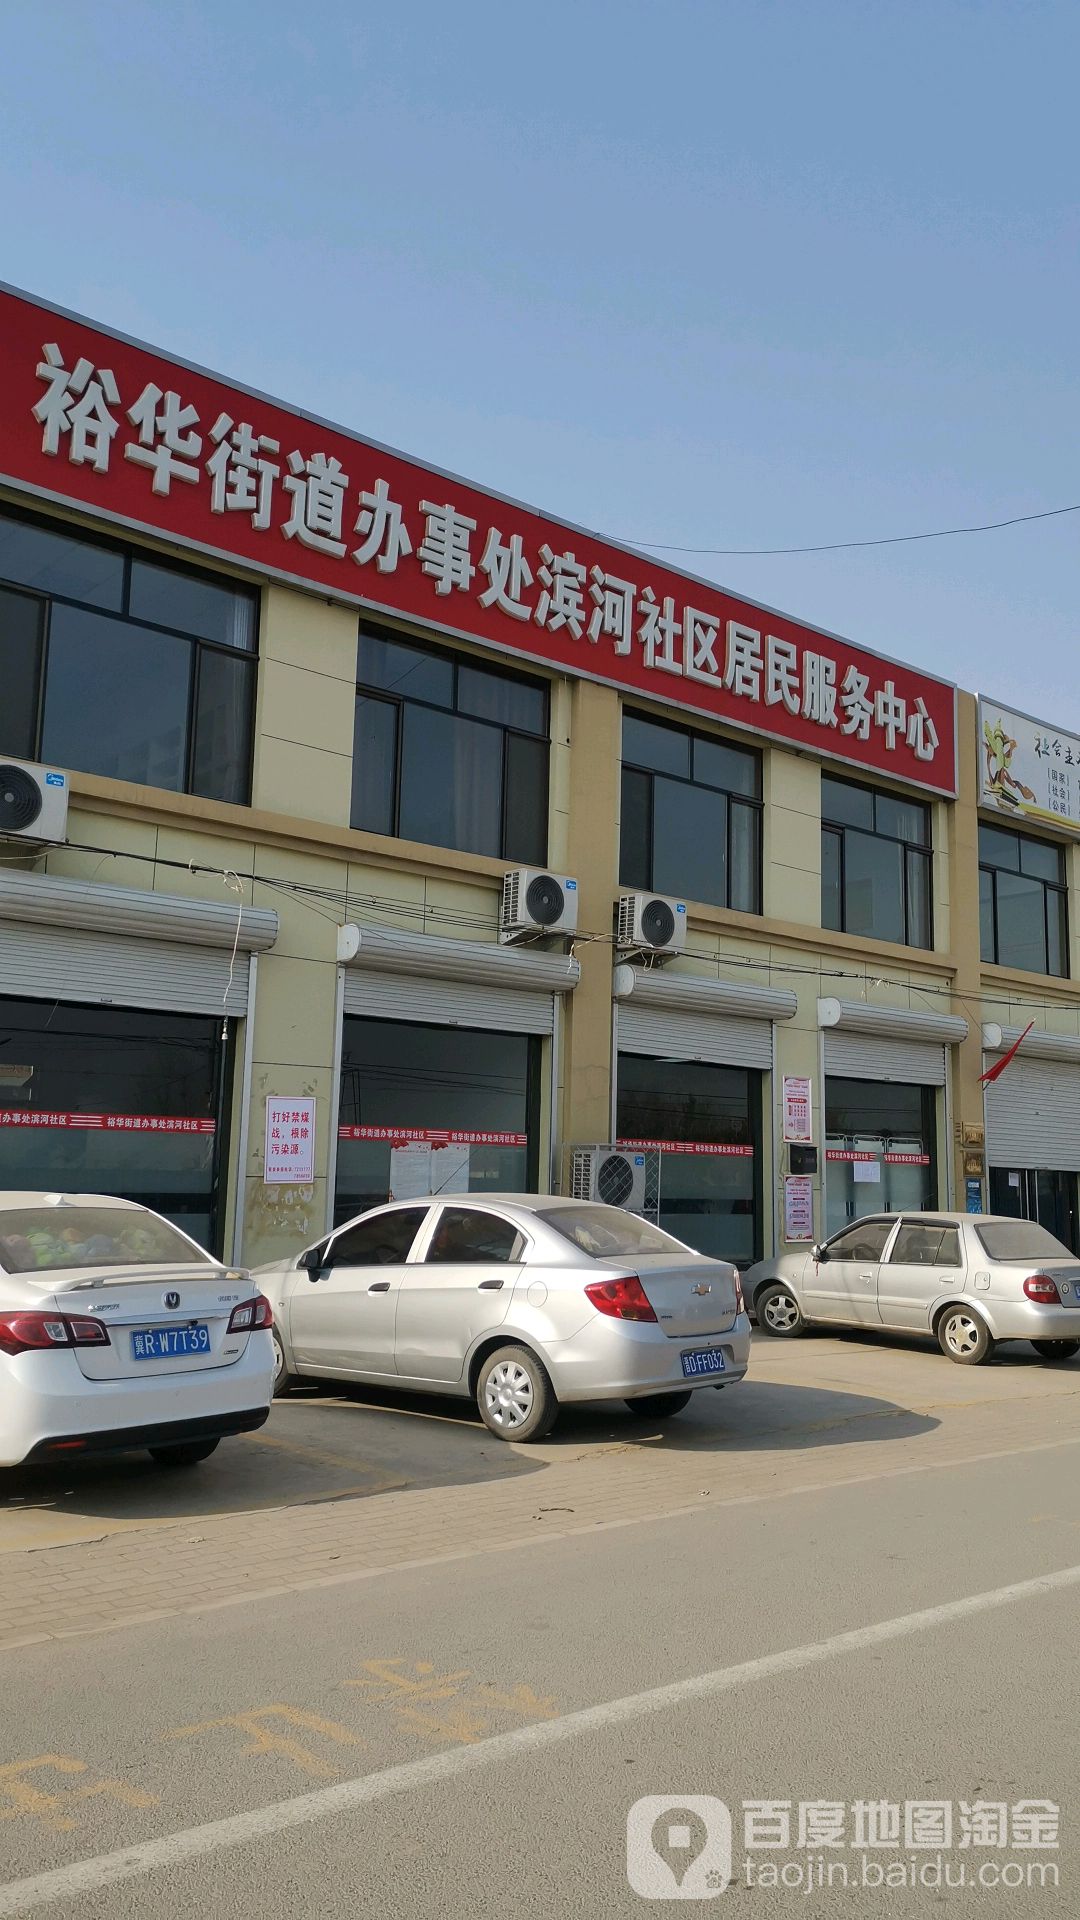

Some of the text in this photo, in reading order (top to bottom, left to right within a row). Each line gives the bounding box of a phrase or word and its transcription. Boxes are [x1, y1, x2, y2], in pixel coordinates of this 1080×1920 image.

[32, 343, 940, 762] 裕华街道办事处滨河社区居民服务中心
[0, 1112, 67, 1125] 办事处滨河社区
[107, 1116, 198, 1130] 裕华街道办事处滨河社区
[272, 1111, 310, 1123] 打好禁煤
[353, 1128, 425, 1140] 裕华街道办事处滨河社区
[451, 1132, 516, 1144] 裕华街道办事处滨河社区
